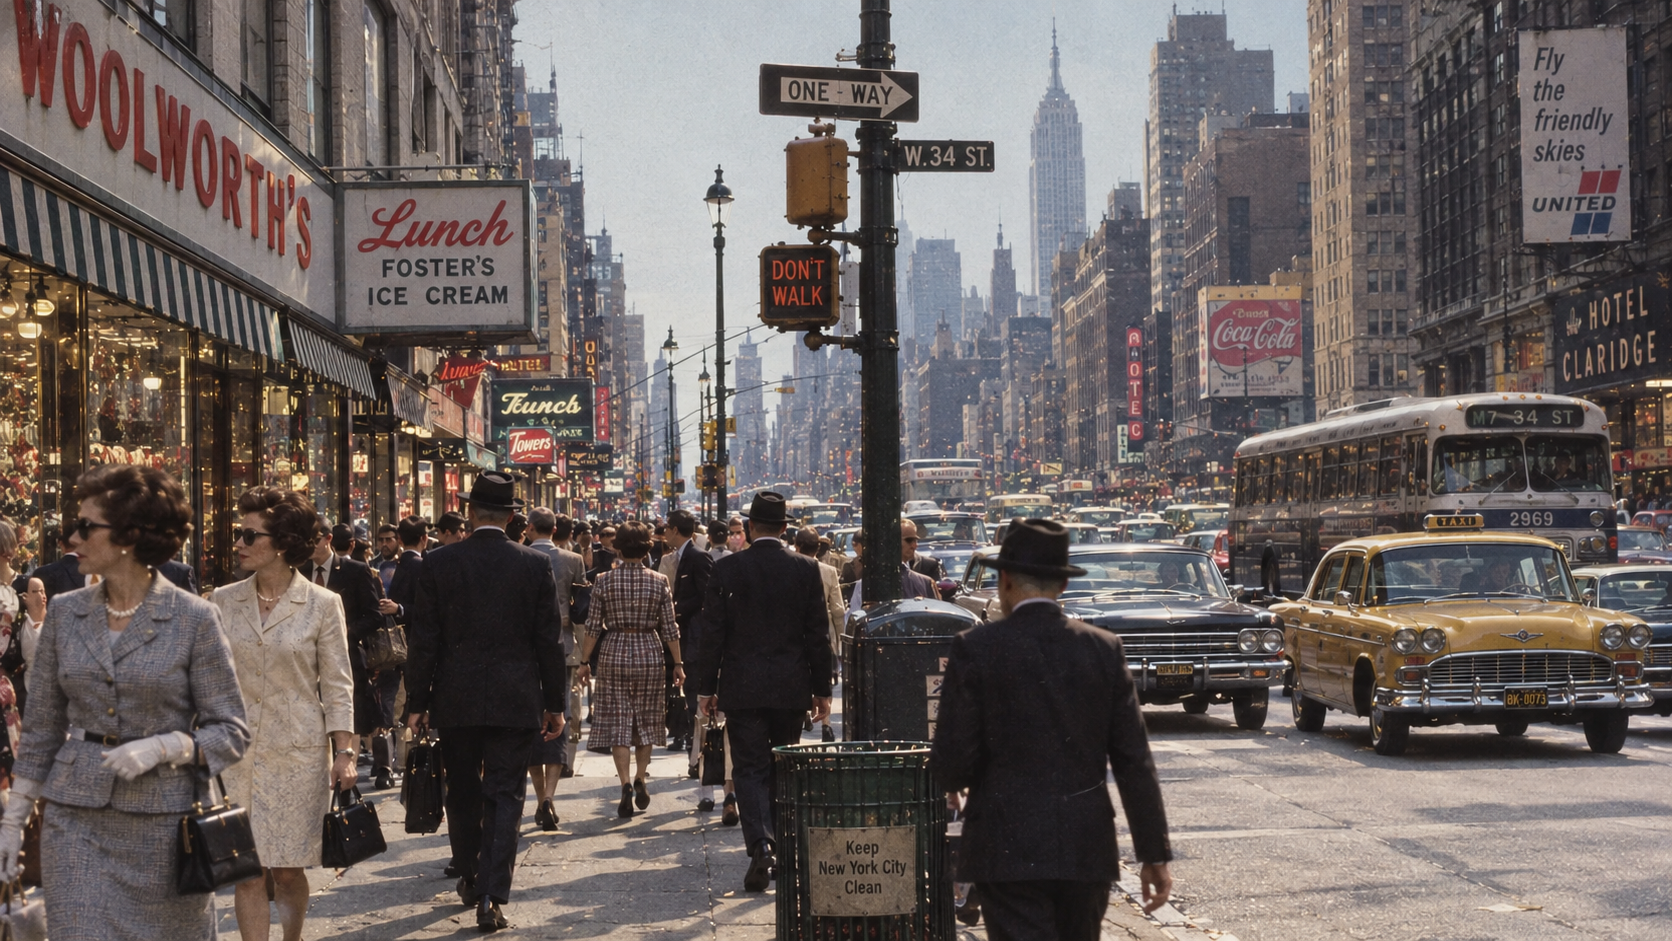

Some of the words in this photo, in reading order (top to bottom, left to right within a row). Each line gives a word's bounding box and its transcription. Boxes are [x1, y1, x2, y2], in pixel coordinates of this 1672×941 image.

[1533, 47, 1565, 76] Fly
[788, 80, 830, 102] ONE
[851, 83, 893, 105] WAY
[1533, 78, 1565, 102] the
[1534, 107, 1613, 135] friendly
[14, 0, 312, 270] WOOLWORTH'S
[965, 146, 991, 167] ST.
[1533, 139, 1585, 162] skies
[1532, 196, 1616, 213] UNITED
[357, 198, 514, 253] Lunch
[382, 255, 495, 278] FOSTER'S
[772, 257, 825, 280] DON'T
[368, 287, 408, 306] ICE
[425, 286, 508, 305] CREAM
[772, 285, 823, 306] WALK
[1589, 285, 1648, 331] HOTEL
[1562, 330, 1656, 382] CLARIDGE
[1472, 410, 1497, 425] M7
[1513, 409, 1538, 425] 34
[1552, 410, 1574, 425] ST
[509, 431, 551, 455] Towers
[1441, 517, 1472, 526] TAXI
[1510, 511, 1553, 527] 2969
[846, 840, 879, 858] Keep
[819, 860, 846, 875] New
[849, 859, 879, 875] York
[883, 859, 907, 877] City
[844, 879, 882, 894] Clean
